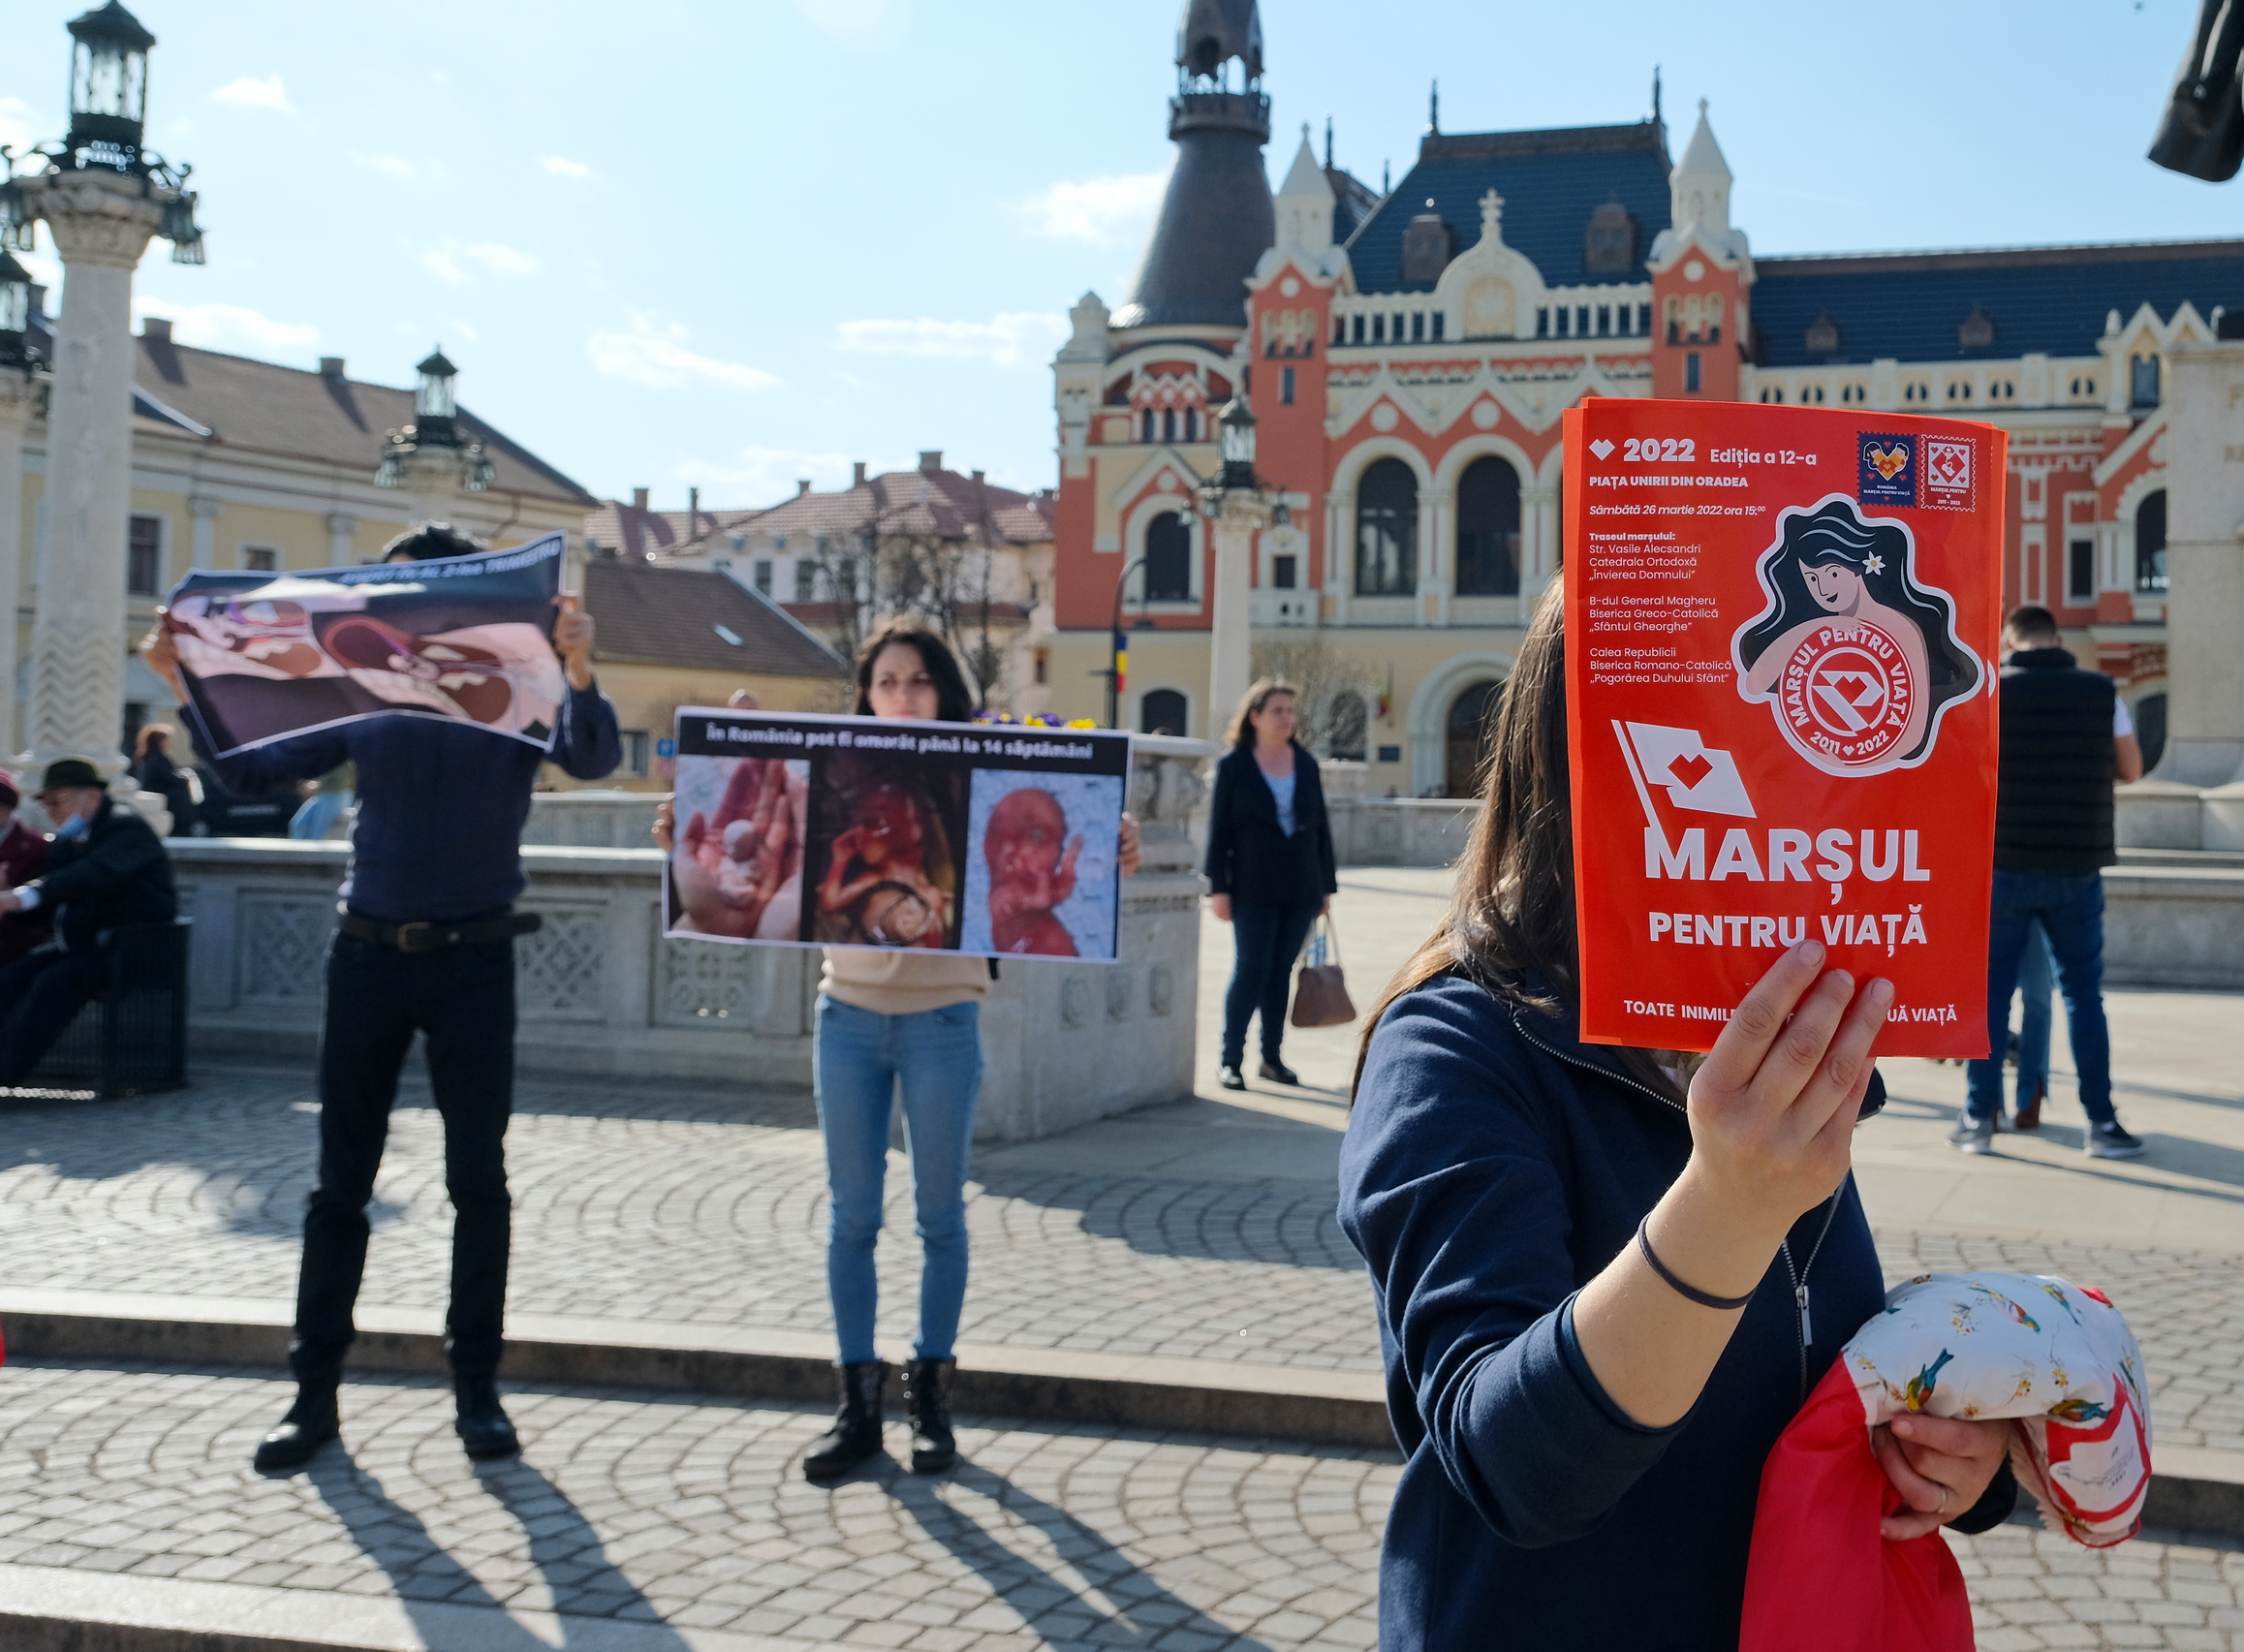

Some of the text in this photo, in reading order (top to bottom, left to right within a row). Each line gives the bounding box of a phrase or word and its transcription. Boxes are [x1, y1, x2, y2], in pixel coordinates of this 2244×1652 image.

[1624, 438, 1816, 468] 2022 Ediția a 12-a
[1590, 476, 1748, 489] PIAȚA UNIRII DIN ORADEA
[1590, 505, 1640, 514] Sâmbătă
[1642, 505, 1656, 514] 26
[1658, 505, 1695, 514] martie
[1697, 506, 1723, 514] 2022
[1628, 532, 1675, 543] marșului:
[1608, 545, 1640, 553] Vasile
[1643, 545, 1700, 553] Alecsandri
[1590, 557, 1697, 566] Catedrala Ortodoxă
[1590, 596, 1715, 608] B-dul General Magheru
[1635, 608, 1718, 617] Greco-Catolică
[1590, 647, 1675, 659] Calea Republicii
[1591, 661, 1731, 670] Biserica Romano-Catolică
[1653, 673, 1693, 682] Duhului
[1787, 628, 1908, 728] MARȘUL PENTRU VIAȚĂ
[705, 721, 1093, 760] În România pot fi omorât până la 14 săptămâni
[1809, 730, 1889, 755] 2011 2022
[1644, 827, 1930, 905] MARȘUL
[1649, 904, 1928, 957] PENTRU VIAȚĂ
[1624, 1000, 1674, 1016] TOATE
[1886, 1004, 1909, 1022] UĂ
[1912, 1004, 1957, 1026] VIAȚĂ
